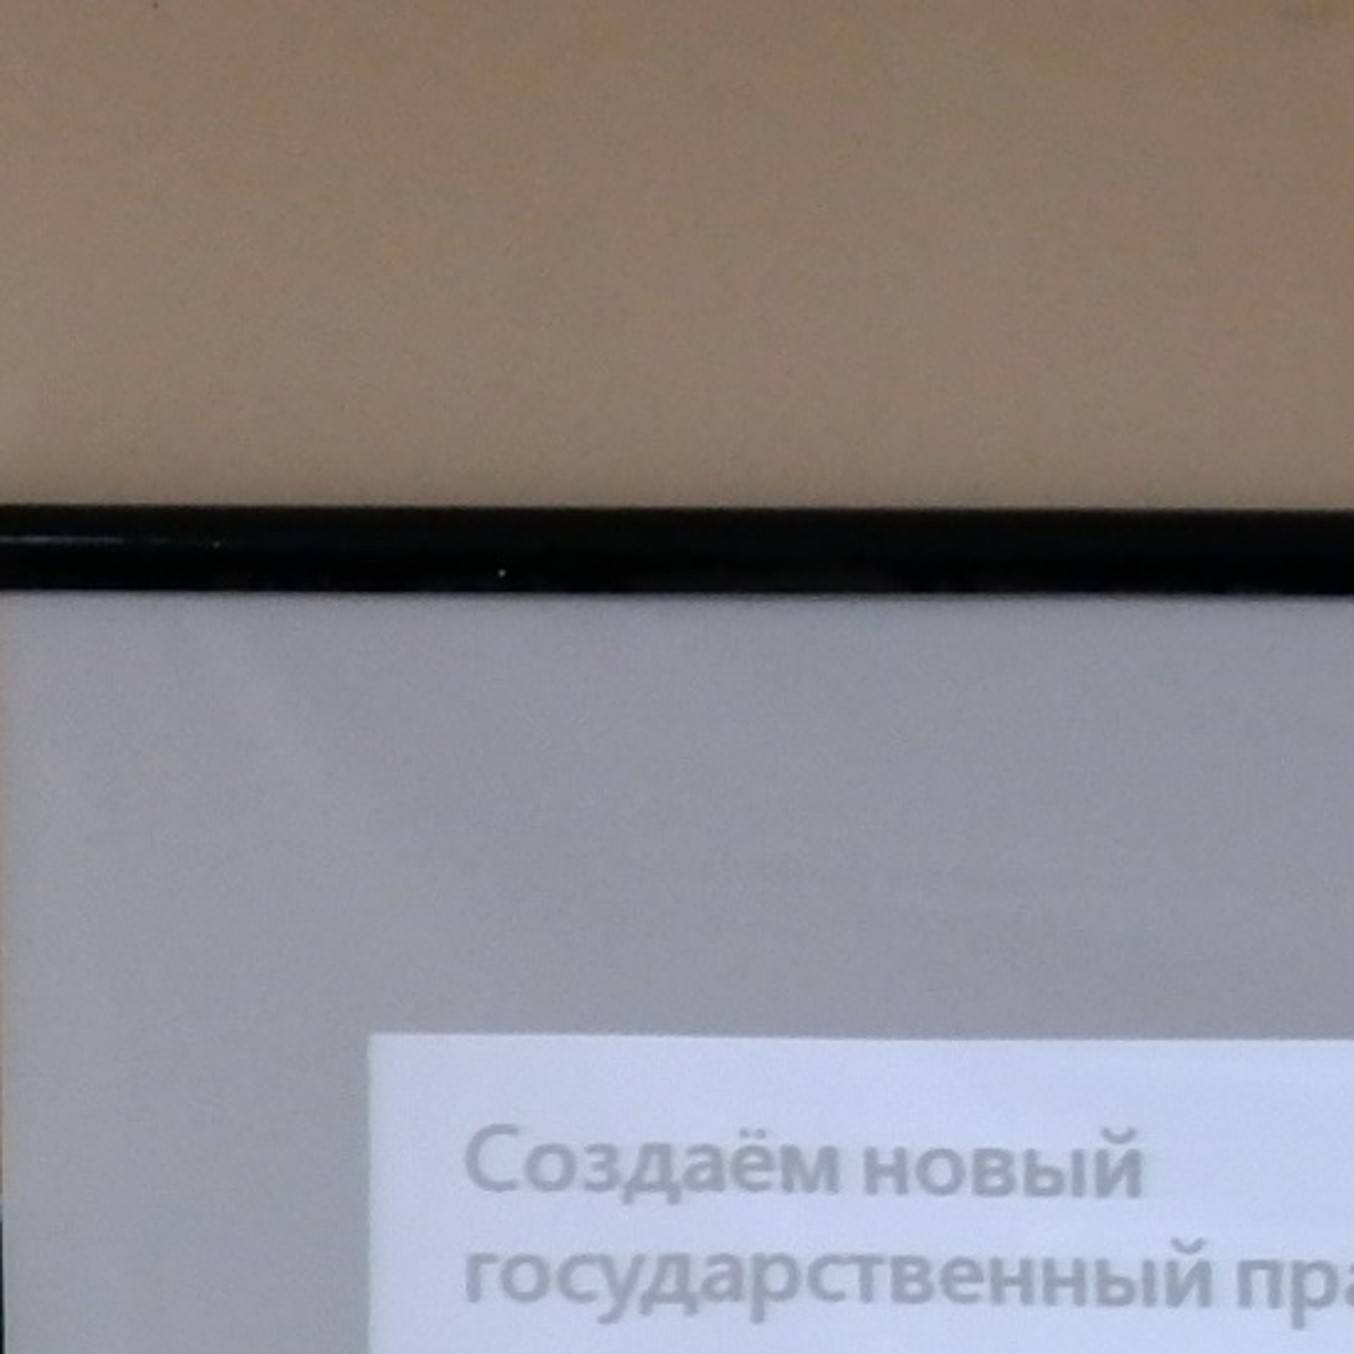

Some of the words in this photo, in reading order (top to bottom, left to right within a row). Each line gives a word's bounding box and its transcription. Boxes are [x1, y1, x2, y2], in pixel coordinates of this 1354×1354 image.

[465, 1124, 841, 1205] Создаём
[863, 1128, 1144, 1198] новый
[466, 1238, 1214, 1324] государственный
